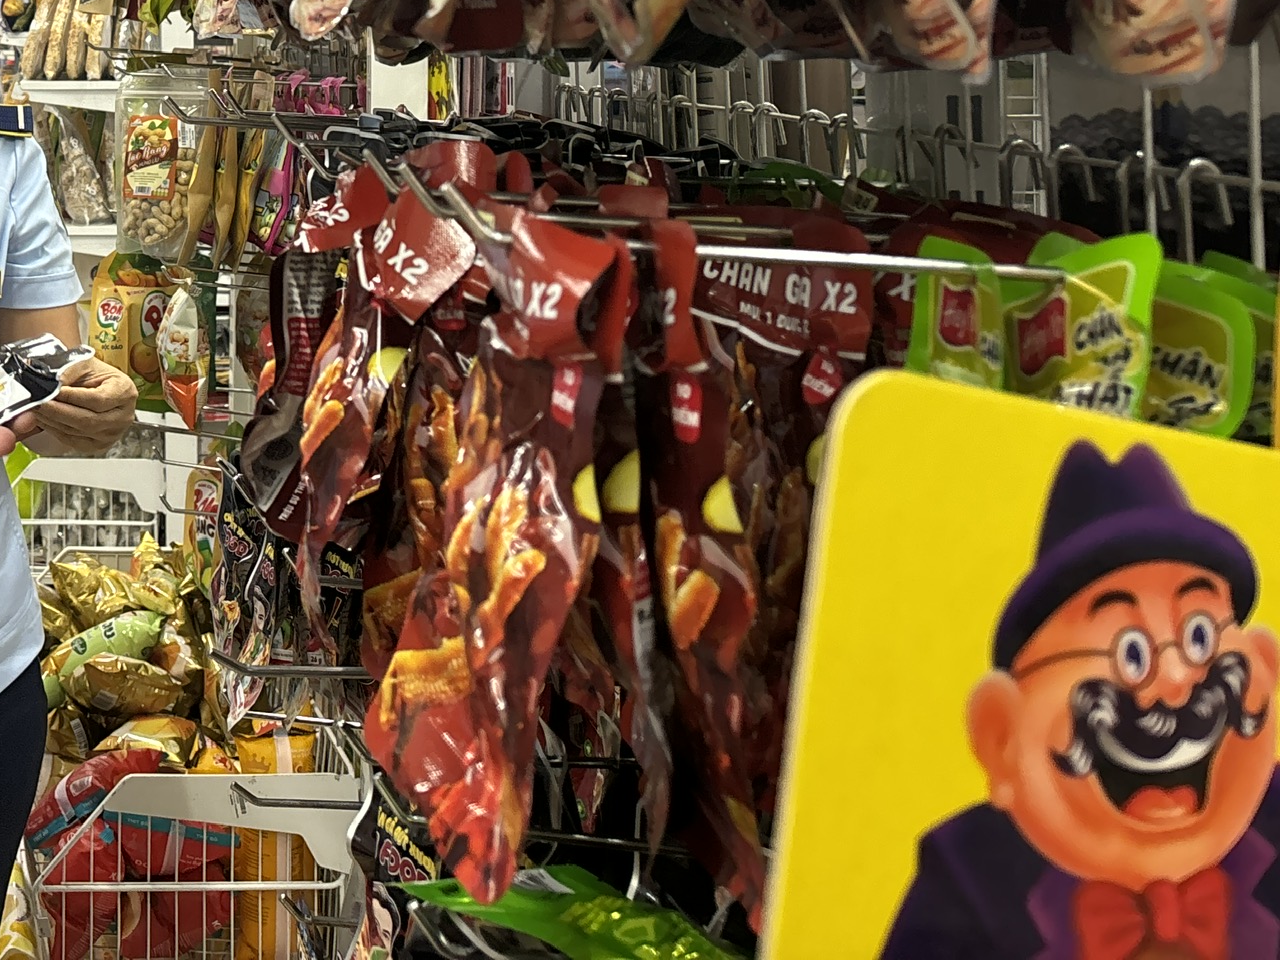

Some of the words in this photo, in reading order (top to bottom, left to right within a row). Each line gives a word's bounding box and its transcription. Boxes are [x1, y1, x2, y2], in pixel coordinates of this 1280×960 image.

[386, 241, 430, 286] X2
[525, 279, 563, 321] X2
[820, 279, 859, 315] X2
